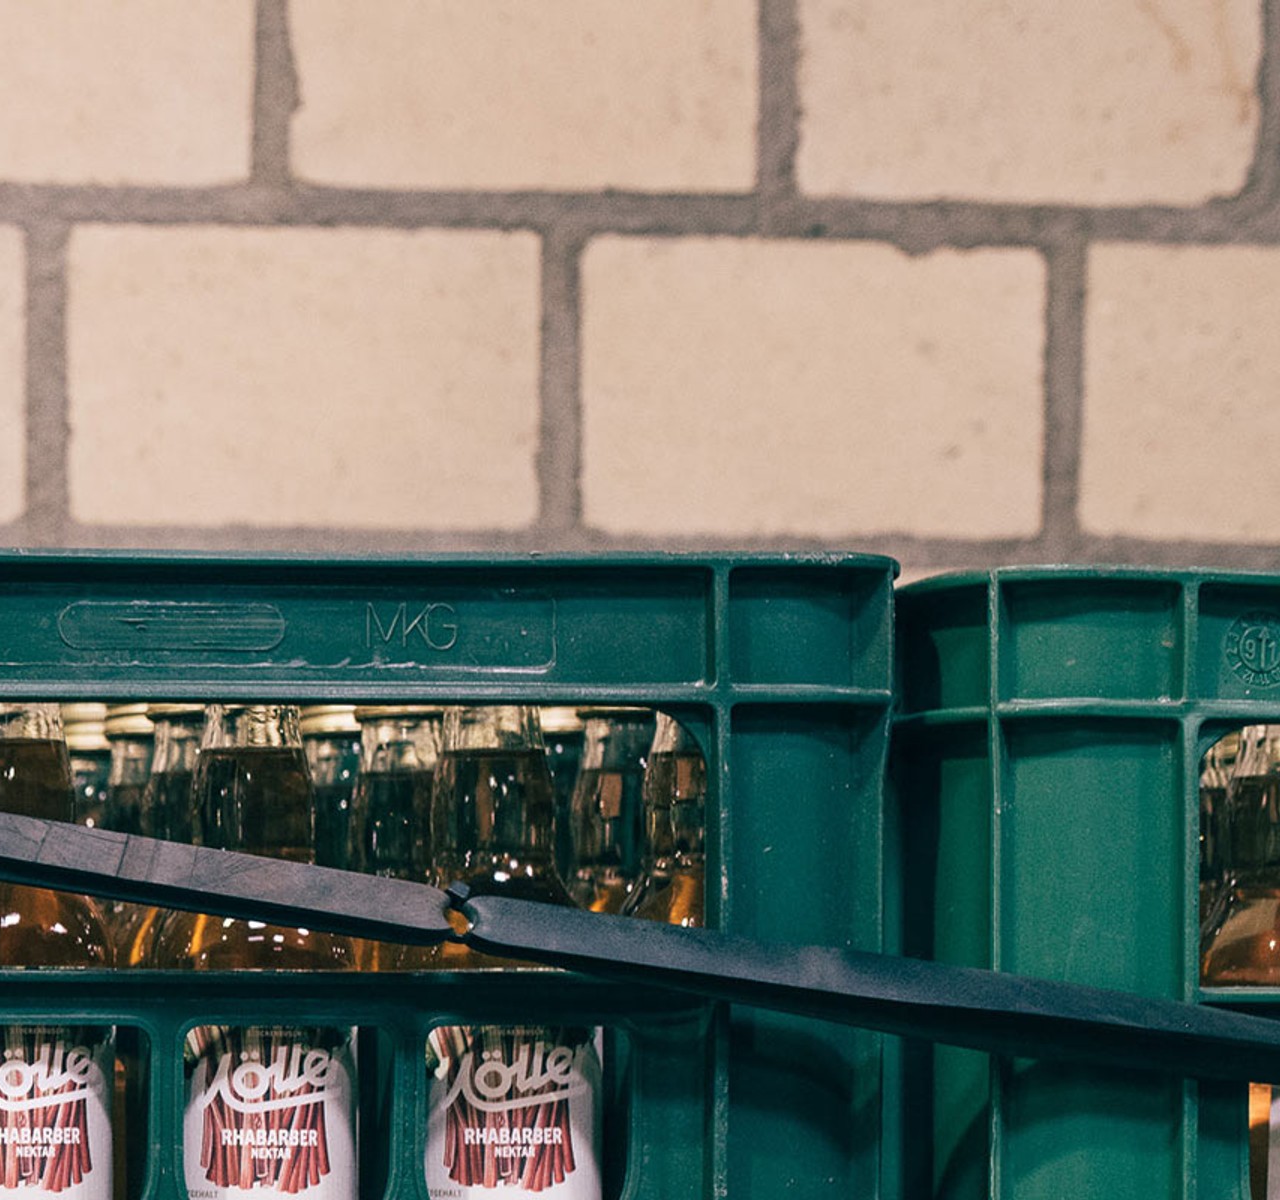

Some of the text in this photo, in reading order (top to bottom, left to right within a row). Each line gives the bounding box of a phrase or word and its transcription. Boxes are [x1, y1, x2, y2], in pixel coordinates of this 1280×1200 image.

[367, 602, 457, 650] MKG
[221, 1129, 318, 1146] RHABARBER
[464, 1128, 562, 1145] RHABARBER
[16, 1146, 55, 1157] NEKTAR
[251, 1148, 291, 1159] NEKTAR
[494, 1146, 535, 1158] NEKTAR
